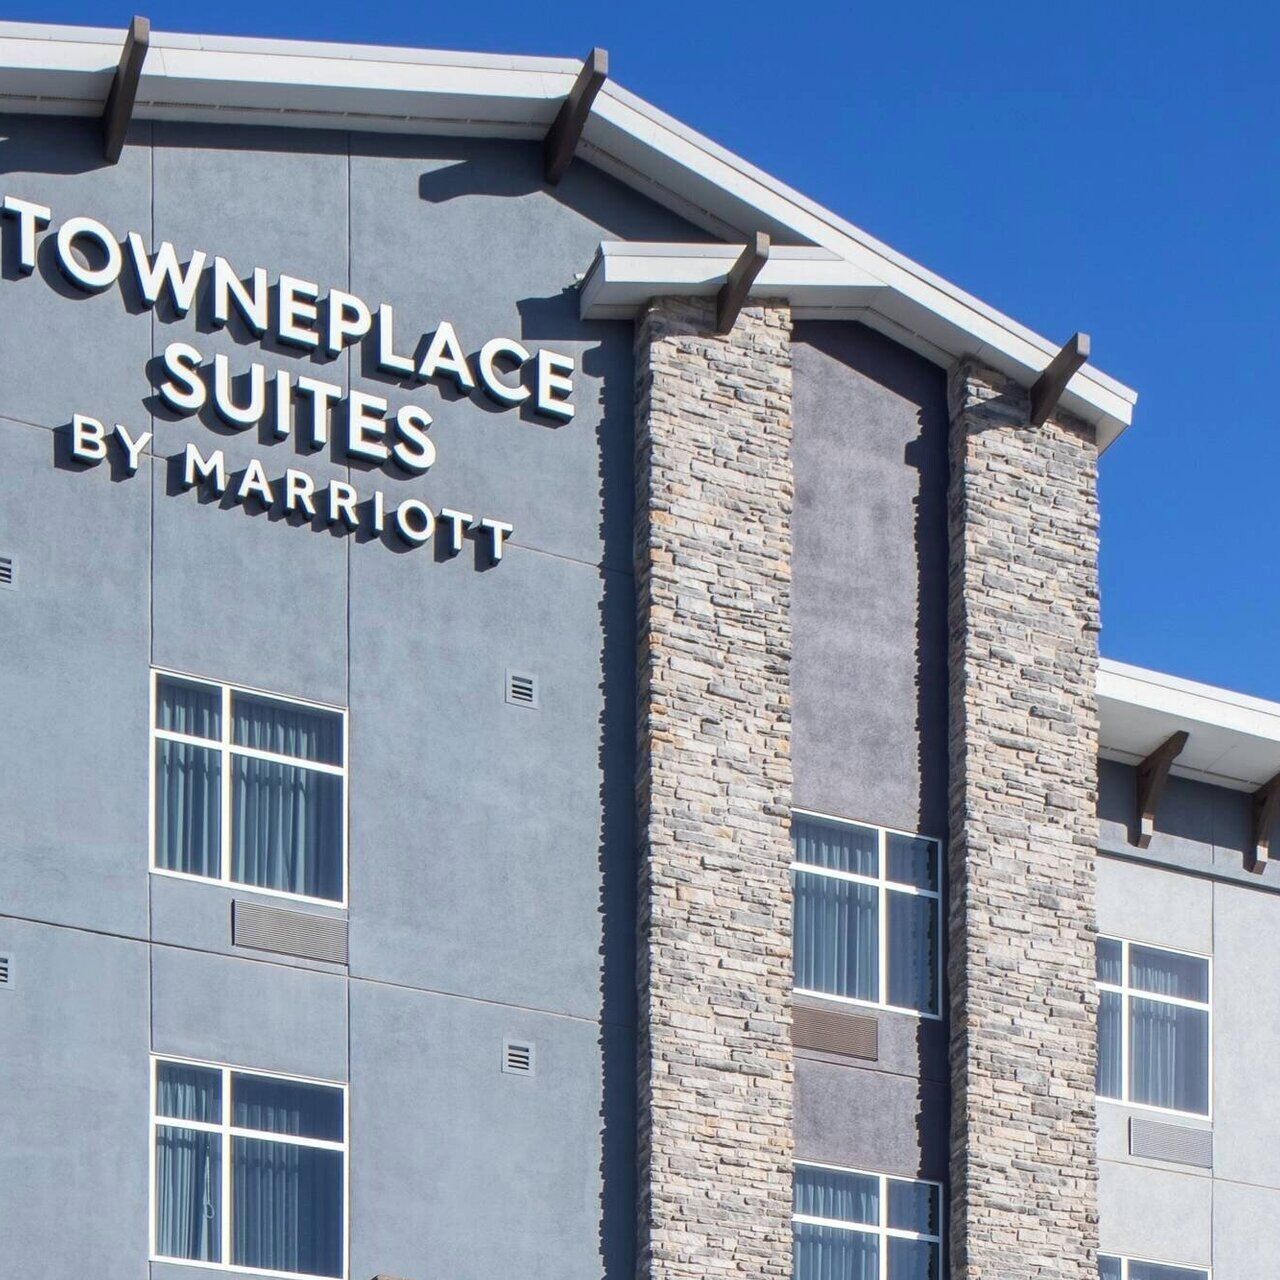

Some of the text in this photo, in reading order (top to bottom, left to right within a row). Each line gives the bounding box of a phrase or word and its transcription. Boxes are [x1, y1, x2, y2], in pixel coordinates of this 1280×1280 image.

[4, 195, 575, 417] TOWNEPLACE
[160, 342, 436, 469] SUITES
[73, 413, 513, 560] BY MARRIOTT
